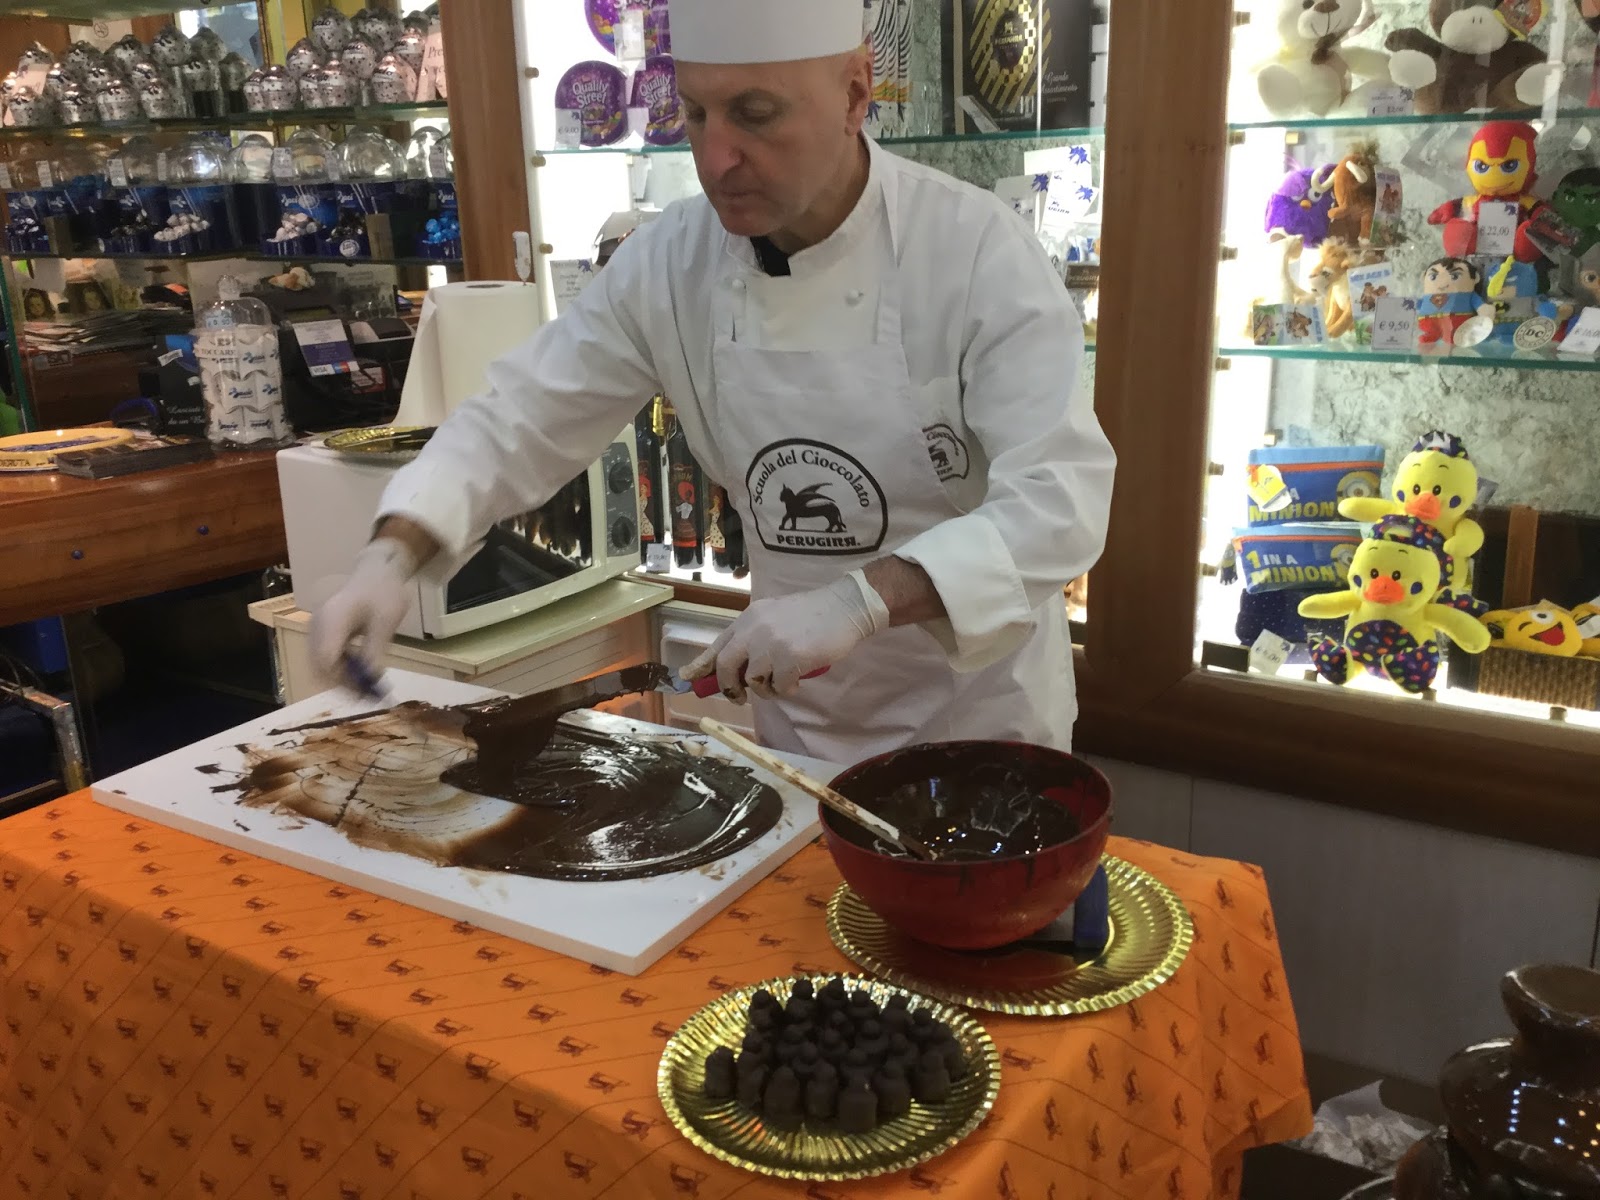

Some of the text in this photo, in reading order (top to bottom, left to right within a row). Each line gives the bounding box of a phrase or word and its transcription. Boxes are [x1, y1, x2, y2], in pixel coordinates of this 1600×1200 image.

[572, 79, 609, 96] Quality
[640, 74, 672, 97] Quality
[576, 91, 607, 109] Street
[644, 84, 672, 109] Street
[1388, 320, 1410, 332] 9,50
[1525, 328, 1545, 338] DC
[753, 449, 870, 508] Scuola del Cioccolato
[776, 533, 858, 548] PERUGINA
[1246, 550, 1299, 569] 1 IN A
[1250, 564, 1337, 585] MINION
